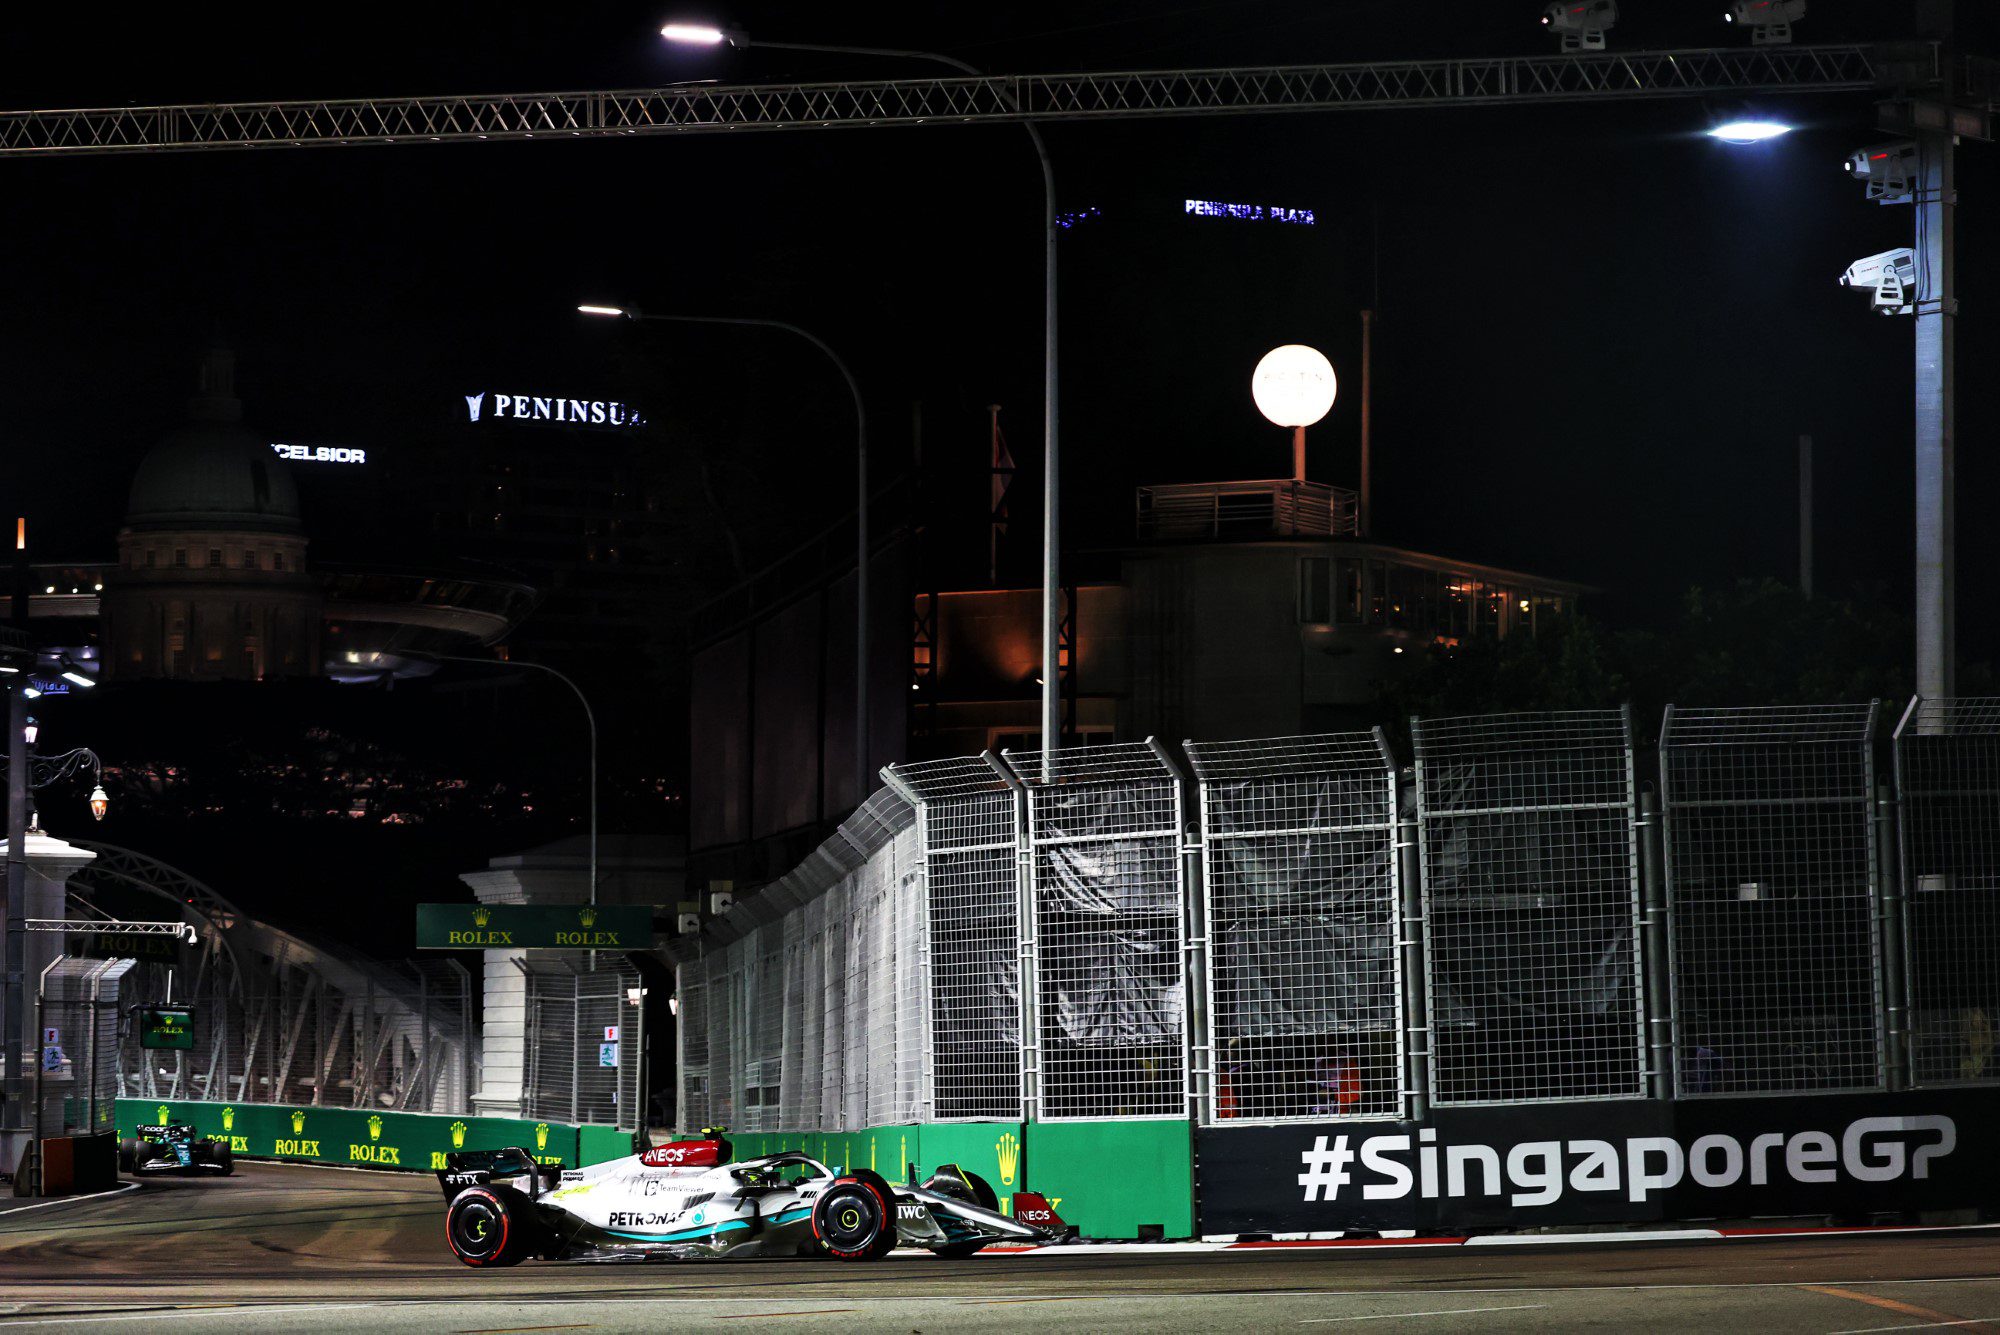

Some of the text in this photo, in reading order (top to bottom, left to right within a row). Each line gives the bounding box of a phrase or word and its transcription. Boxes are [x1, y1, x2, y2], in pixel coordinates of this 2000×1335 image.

[270, 443, 366, 463] CELSIOR
[449, 931, 513, 945] ROLEX
[555, 931, 620, 945] ROLEX
[99, 935, 174, 957] ROLEX
[274, 1139, 321, 1157] ROLEX
[350, 1144, 400, 1165] ROLEX
[645, 1148, 686, 1162] INEOS
[1297, 1114, 1957, 1207] #SingaporeGP
[457, 1174, 480, 1185] FTX
[897, 1205, 926, 1219] IWC
[1018, 1210, 1051, 1221] INEOS
